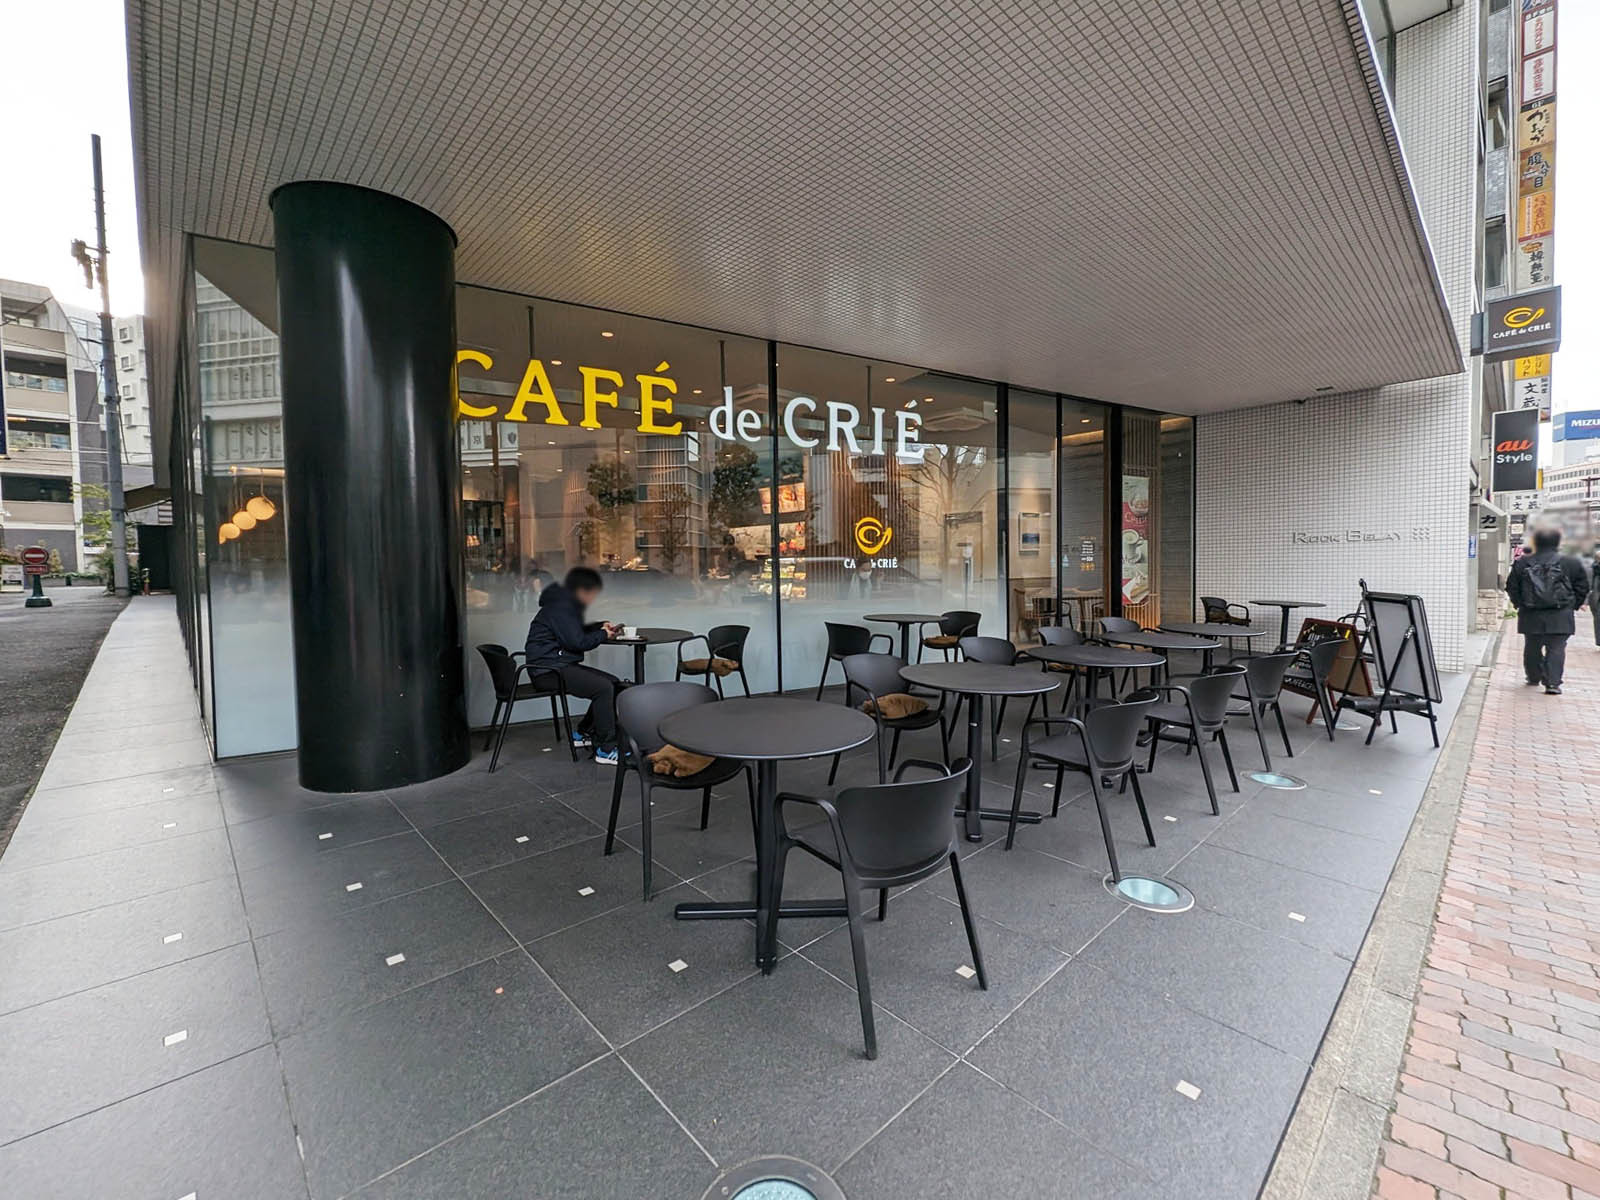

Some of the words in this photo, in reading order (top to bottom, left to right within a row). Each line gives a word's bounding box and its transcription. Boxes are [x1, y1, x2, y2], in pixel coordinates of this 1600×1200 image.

[1493, 329, 1517, 339] CAFÉ
[1527, 321, 1551, 332] CRIÉ
[457, 350, 683, 436] CAFÉ
[709, 386, 762, 442] de
[783, 397, 925, 458] CRIÉ
[1496, 439, 1534, 452] au
[1496, 452, 1533, 464] Style
[877, 556, 898, 569] CRIÉ
